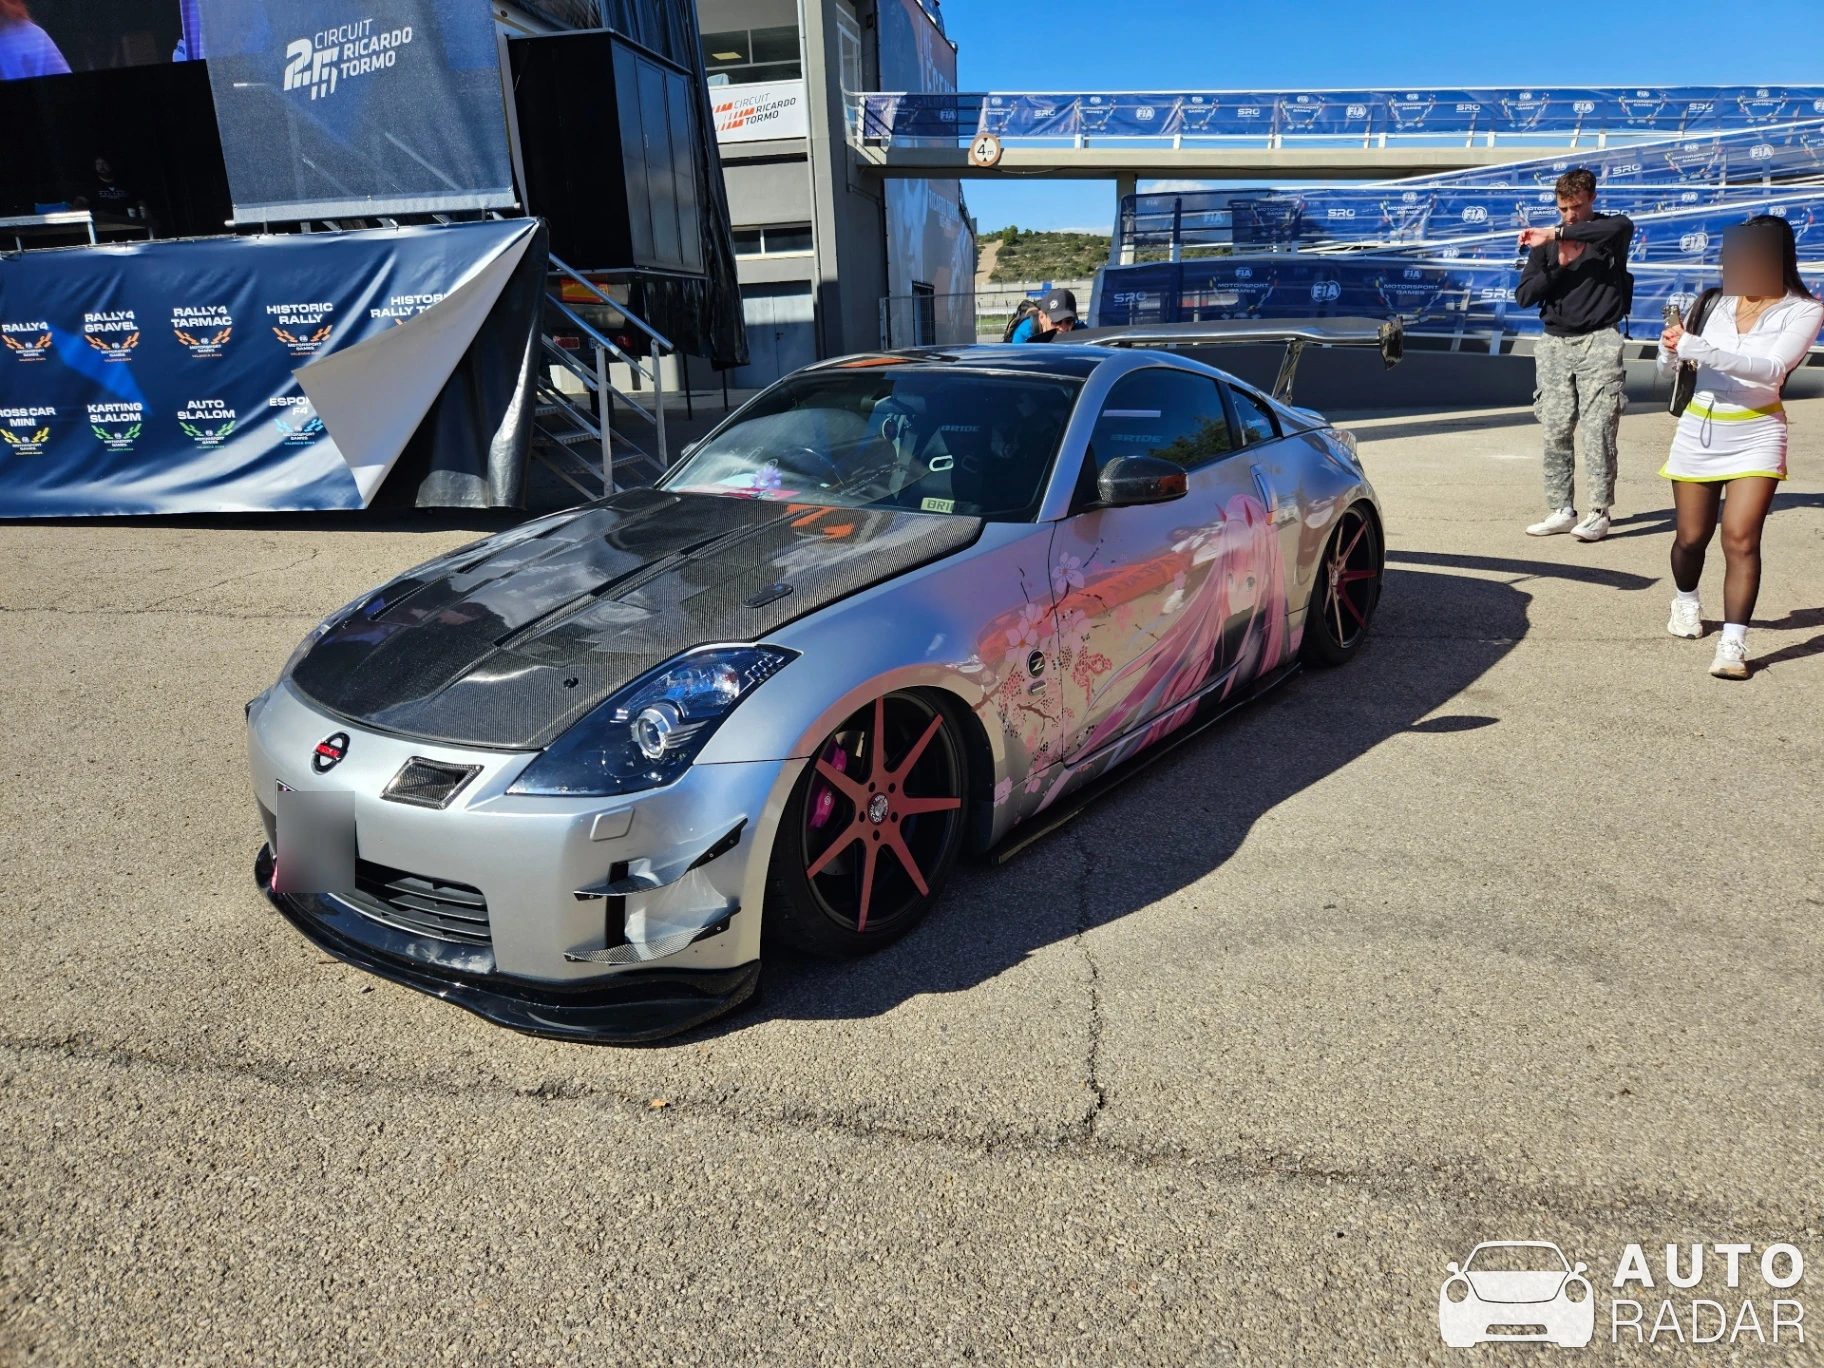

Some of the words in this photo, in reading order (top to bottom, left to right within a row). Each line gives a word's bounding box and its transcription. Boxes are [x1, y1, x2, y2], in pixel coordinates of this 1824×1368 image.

[314, 19, 373, 49] CIRCUIT
[343, 26, 412, 60] RICARDO
[341, 50, 396, 79] TORMO
[734, 93, 770, 109] CIRCUIT
[756, 98, 796, 114] RICARDO
[746, 111, 779, 125] TORMO
[977, 144, 986, 155] 4
[1613, 164, 1641, 174] SRO
[1114, 292, 1147, 302] SRO
[173, 306, 228, 317] RALLY4
[266, 303, 333, 314] HISTORIC
[370, 306, 413, 318] RALLY
[84, 311, 135, 322] RALLY4
[171, 316, 232, 328] TARMAC
[278, 314, 322, 324] RALLY
[2, 322, 48, 332] RALLY4
[84, 321, 139, 332] GRAVEL
[87, 402, 143, 412] KARTING
[187, 400, 224, 409] AUTO
[29, 407, 56, 416] CAR
[177, 409, 236, 419] SLALOM
[293, 407, 308, 415] F4
[9, 418, 36, 427] MINI
[90, 413, 141, 423] SLALOM
[1111, 434, 1162, 442] BRIDE
